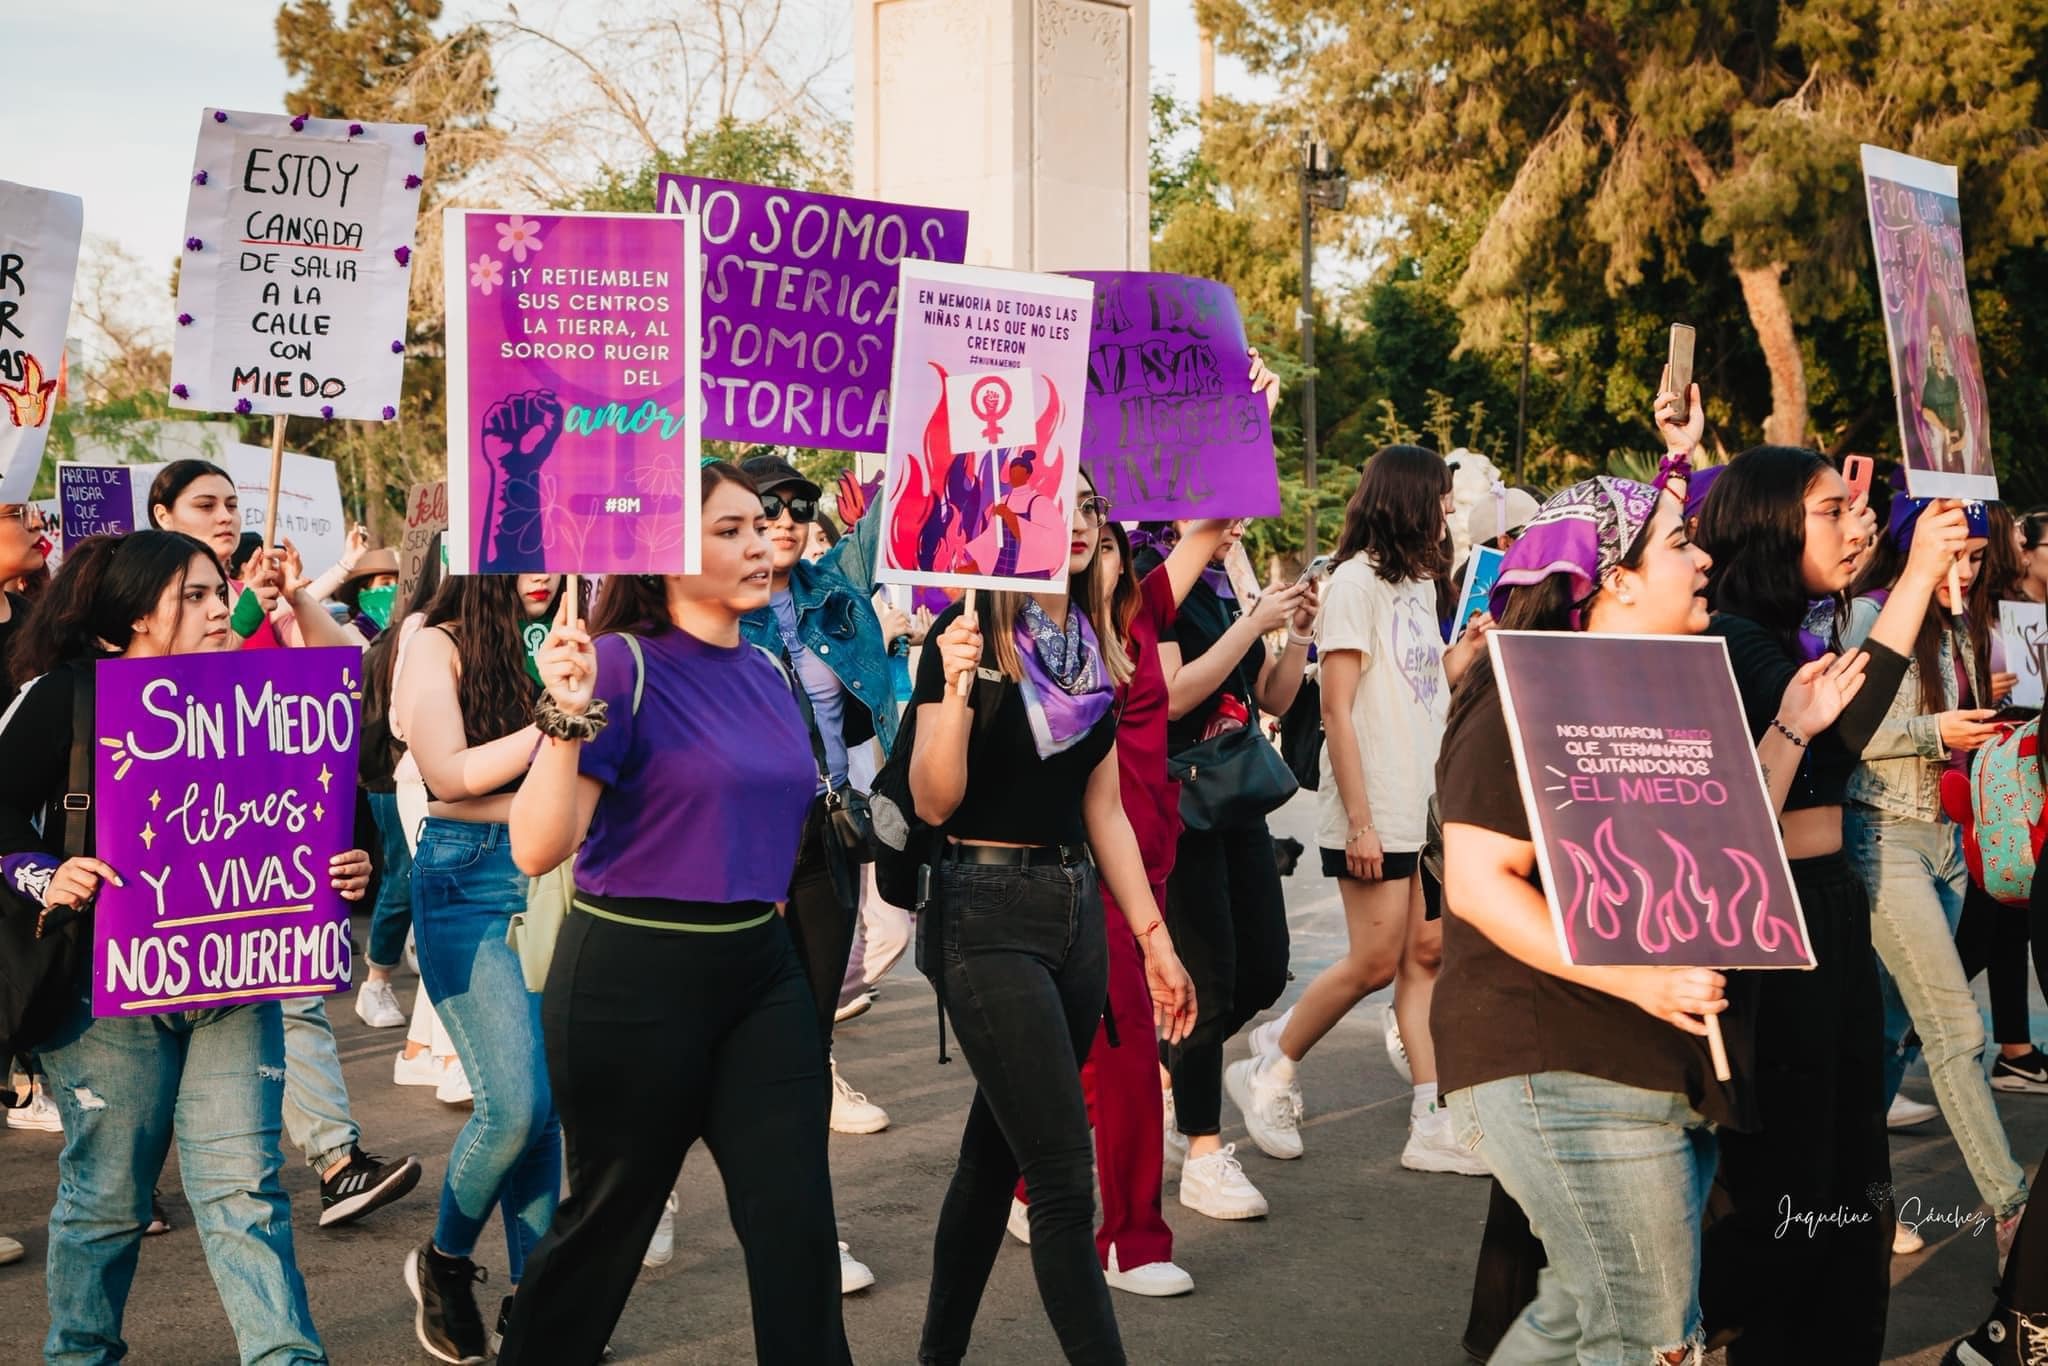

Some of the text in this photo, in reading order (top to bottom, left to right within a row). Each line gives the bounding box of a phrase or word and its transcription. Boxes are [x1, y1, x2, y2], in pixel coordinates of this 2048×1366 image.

[243, 148, 359, 208] ESTOY
[246, 211, 363, 248] CANSADA
[664, 179, 945, 266] NO SOMOS
[240, 252, 356, 282] DE SALIR
[511, 267, 669, 288] ¡Y RETIEMBLEN
[262, 282, 321, 306] A LA
[518, 293, 670, 312] SUS CENTROS
[919, 290, 1078, 322] EN MEMORIA DE TODAS LAS
[252, 312, 331, 336] CALLE
[524, 318, 670, 338] LA TIERRA, AL
[924, 309, 1070, 340] NIÑAS A LAS QUE NO LES
[270, 341, 311, 361] CON
[501, 342, 670, 361] SORORO RUGIR
[701, 315, 883, 377] SOMOS
[967, 336, 1026, 354] CREYERON
[624, 370, 662, 386] DEL
[1087, 339, 1224, 396] VISAR
[232, 366, 346, 398] MIEDO
[565, 400, 685, 440] amor
[61, 468, 121, 485] HARTA DE
[66, 486, 105, 502] AVISAR
[604, 497, 641, 513] #8M
[74, 504, 100, 519] QUE
[246, 508, 282, 528] EDA
[1556, 724, 1713, 740] NOS QUITARON TANTO
[1565, 741, 1714, 759] QUE TERMINARON
[1576, 758, 1711, 776] QUITANDONOS
[1569, 776, 1728, 805] EL MIEDO
[165, 782, 308, 845] libres
[140, 845, 317, 915] Y VIVAS
[106, 918, 352, 996] NOS QUEREMOS
